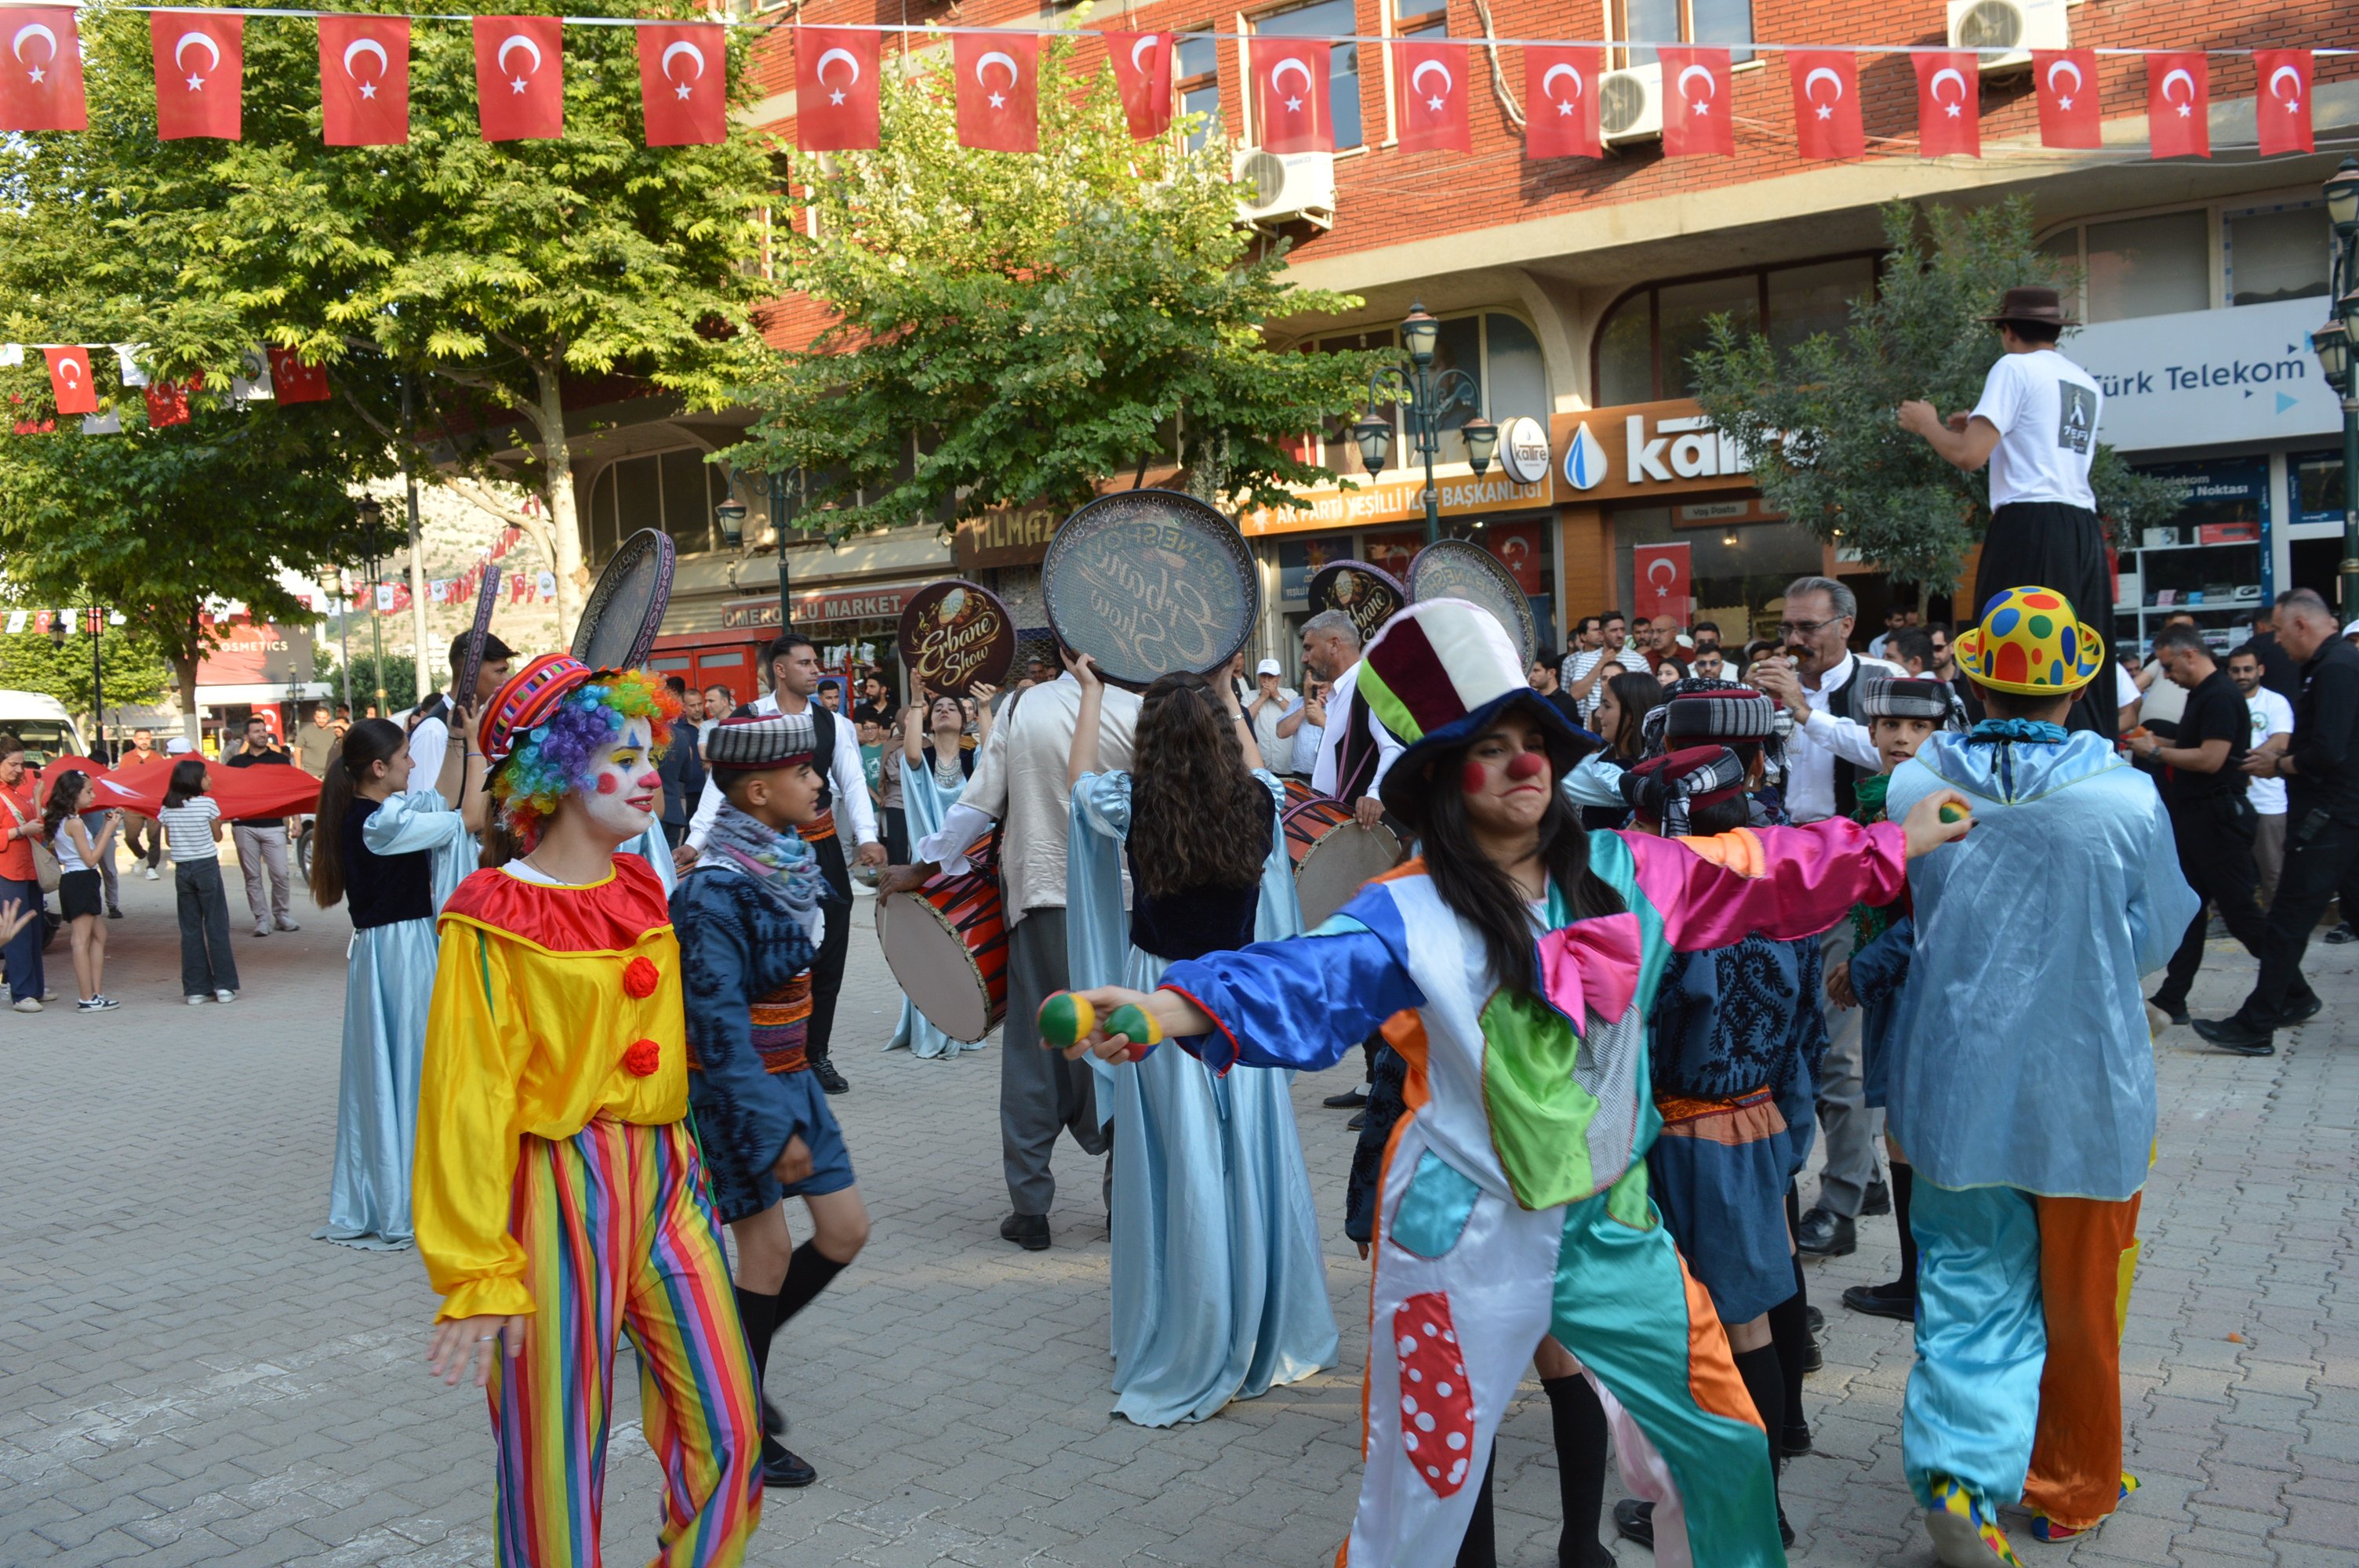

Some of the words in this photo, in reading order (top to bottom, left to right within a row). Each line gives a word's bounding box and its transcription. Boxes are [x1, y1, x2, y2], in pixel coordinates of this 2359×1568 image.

[2165, 358, 2305, 391] Telekom
[1276, 503, 1298, 524] AK
[1346, 487, 1402, 518] YEŞİLLİ
[1405, 486, 1438, 512] İLÇ
[2197, 485, 2248, 497] Noktası
[1350, 591, 1387, 630] bane
[214, 641, 289, 652] OSMETICS
[917, 617, 990, 677] Erbane
[941, 645, 989, 687] Show
